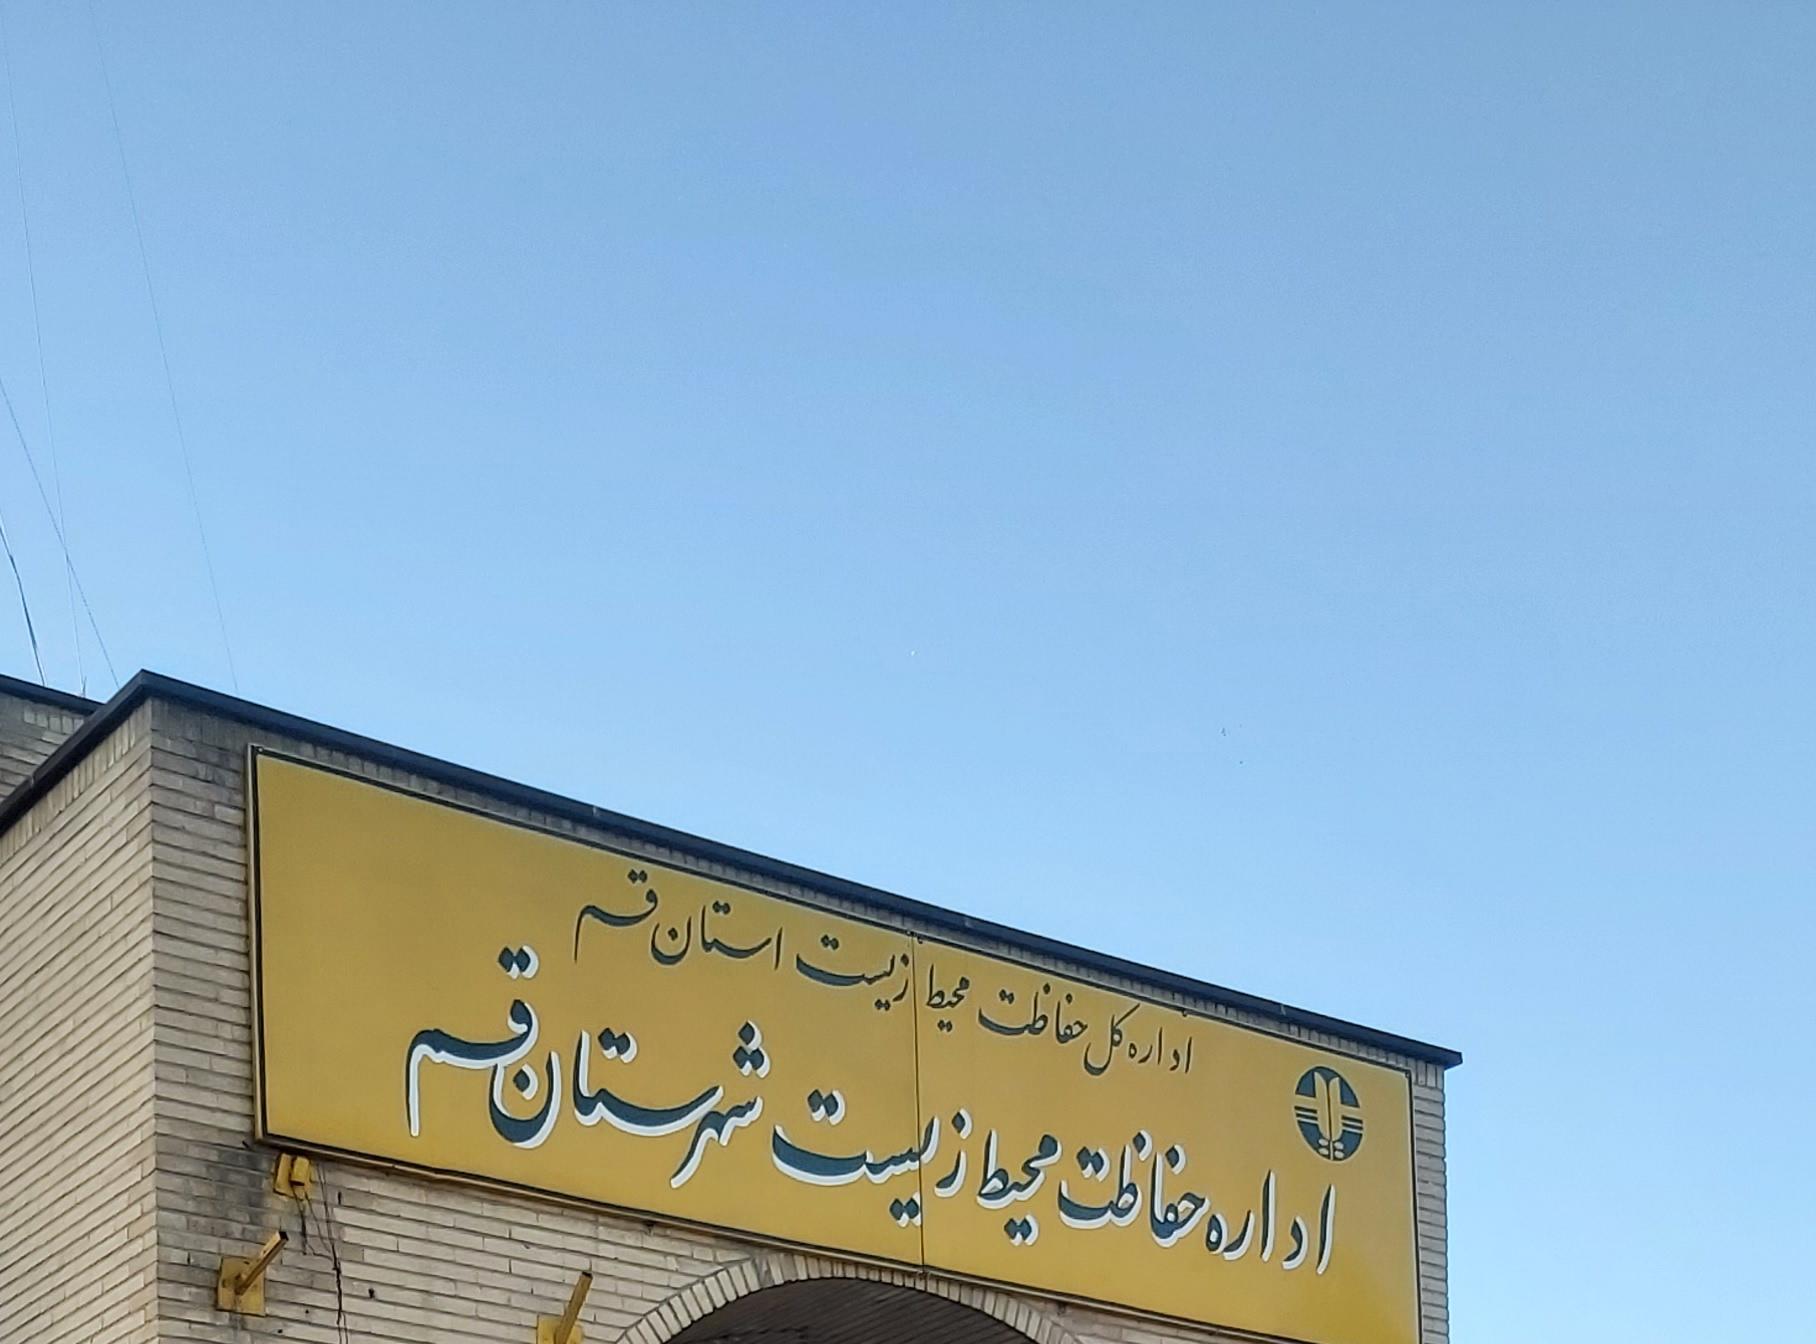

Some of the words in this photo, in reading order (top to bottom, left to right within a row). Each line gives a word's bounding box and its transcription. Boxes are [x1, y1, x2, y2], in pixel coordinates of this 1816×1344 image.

[573, 868, 658, 963] قم
[650, 900, 783, 971] استان
[796, 934, 910, 1012] زیست
[925, 963, 970, 1033] محیط
[978, 982, 1089, 1045] حفاظت
[405, 943, 541, 1138] قم
[1083, 1004, 1141, 1076] کل
[1127, 1028, 1194, 1074] اداره
[488, 1020, 771, 1188] شهرستان
[771, 1087, 973, 1228] زیست
[976, 1128, 1063, 1246] محیط
[1057, 1129, 1209, 1247] حفاظت
[1205, 1169, 1336, 1275] اداره
